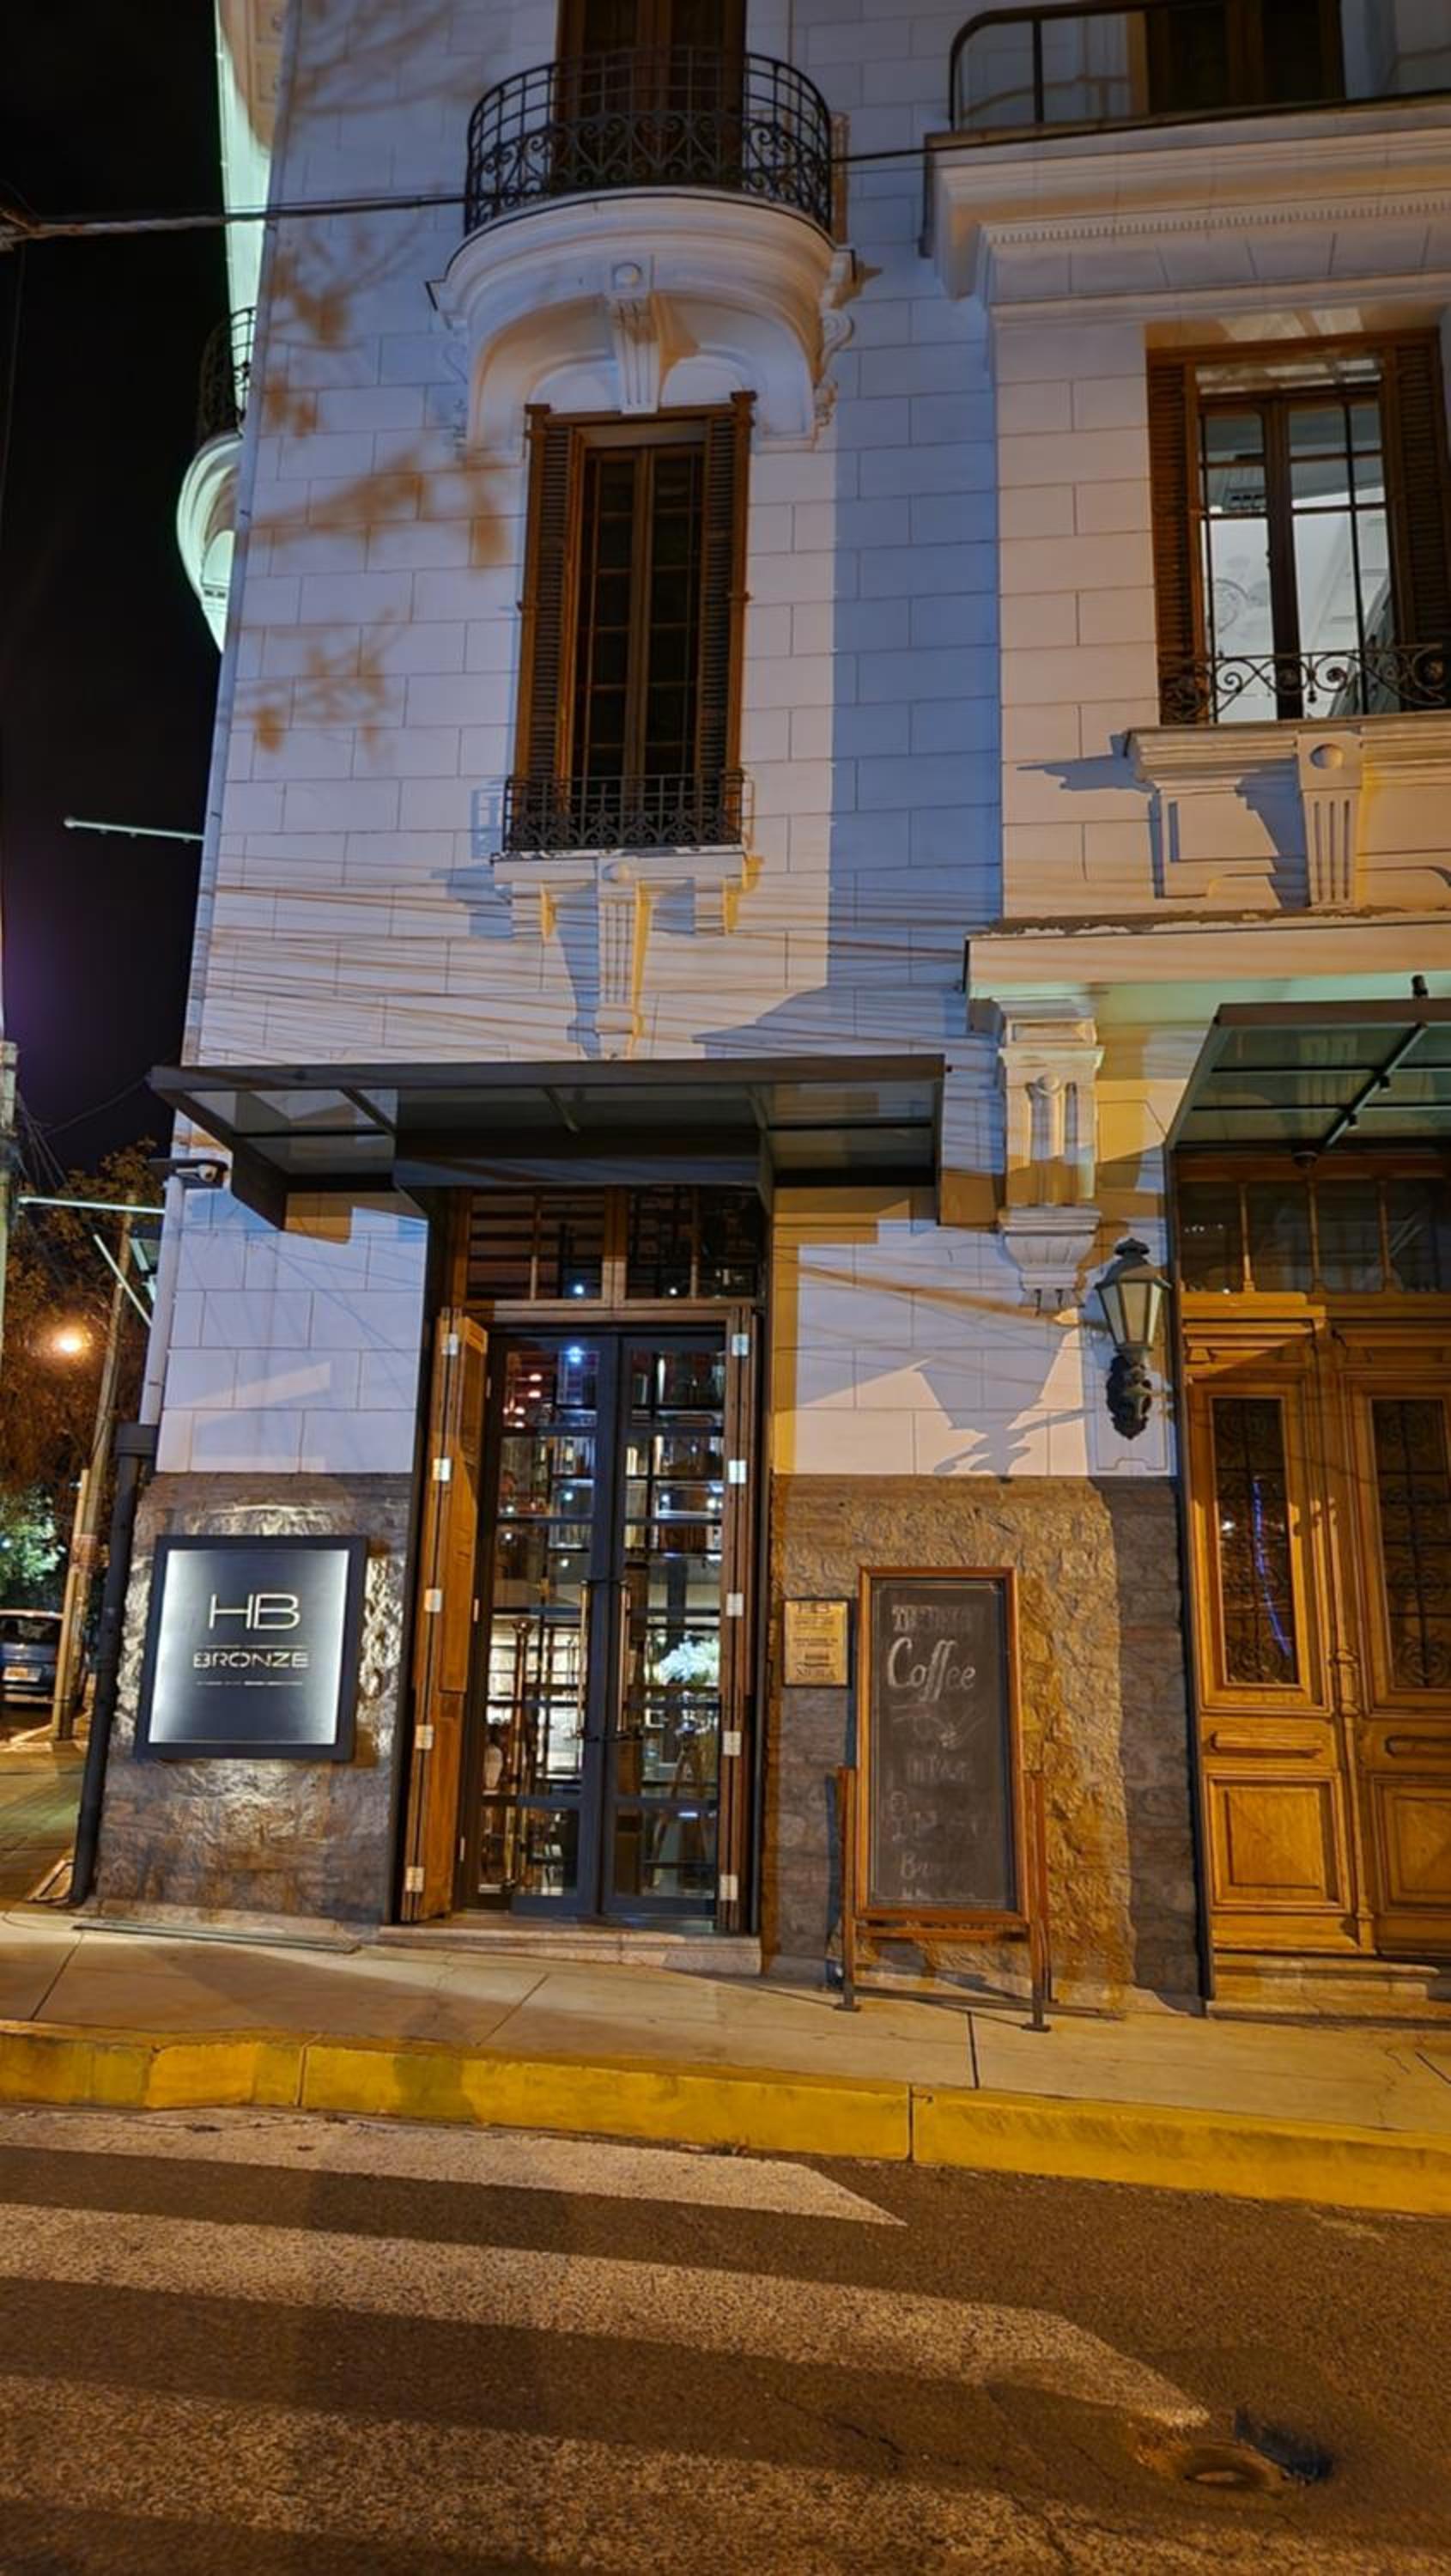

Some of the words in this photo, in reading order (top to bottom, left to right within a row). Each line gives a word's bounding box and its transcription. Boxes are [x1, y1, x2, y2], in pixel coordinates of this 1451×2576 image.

[209, 1593, 301, 1630] HB
[192, 1652, 310, 1669] BRONZE
[887, 1636, 976, 1703] Coffee
